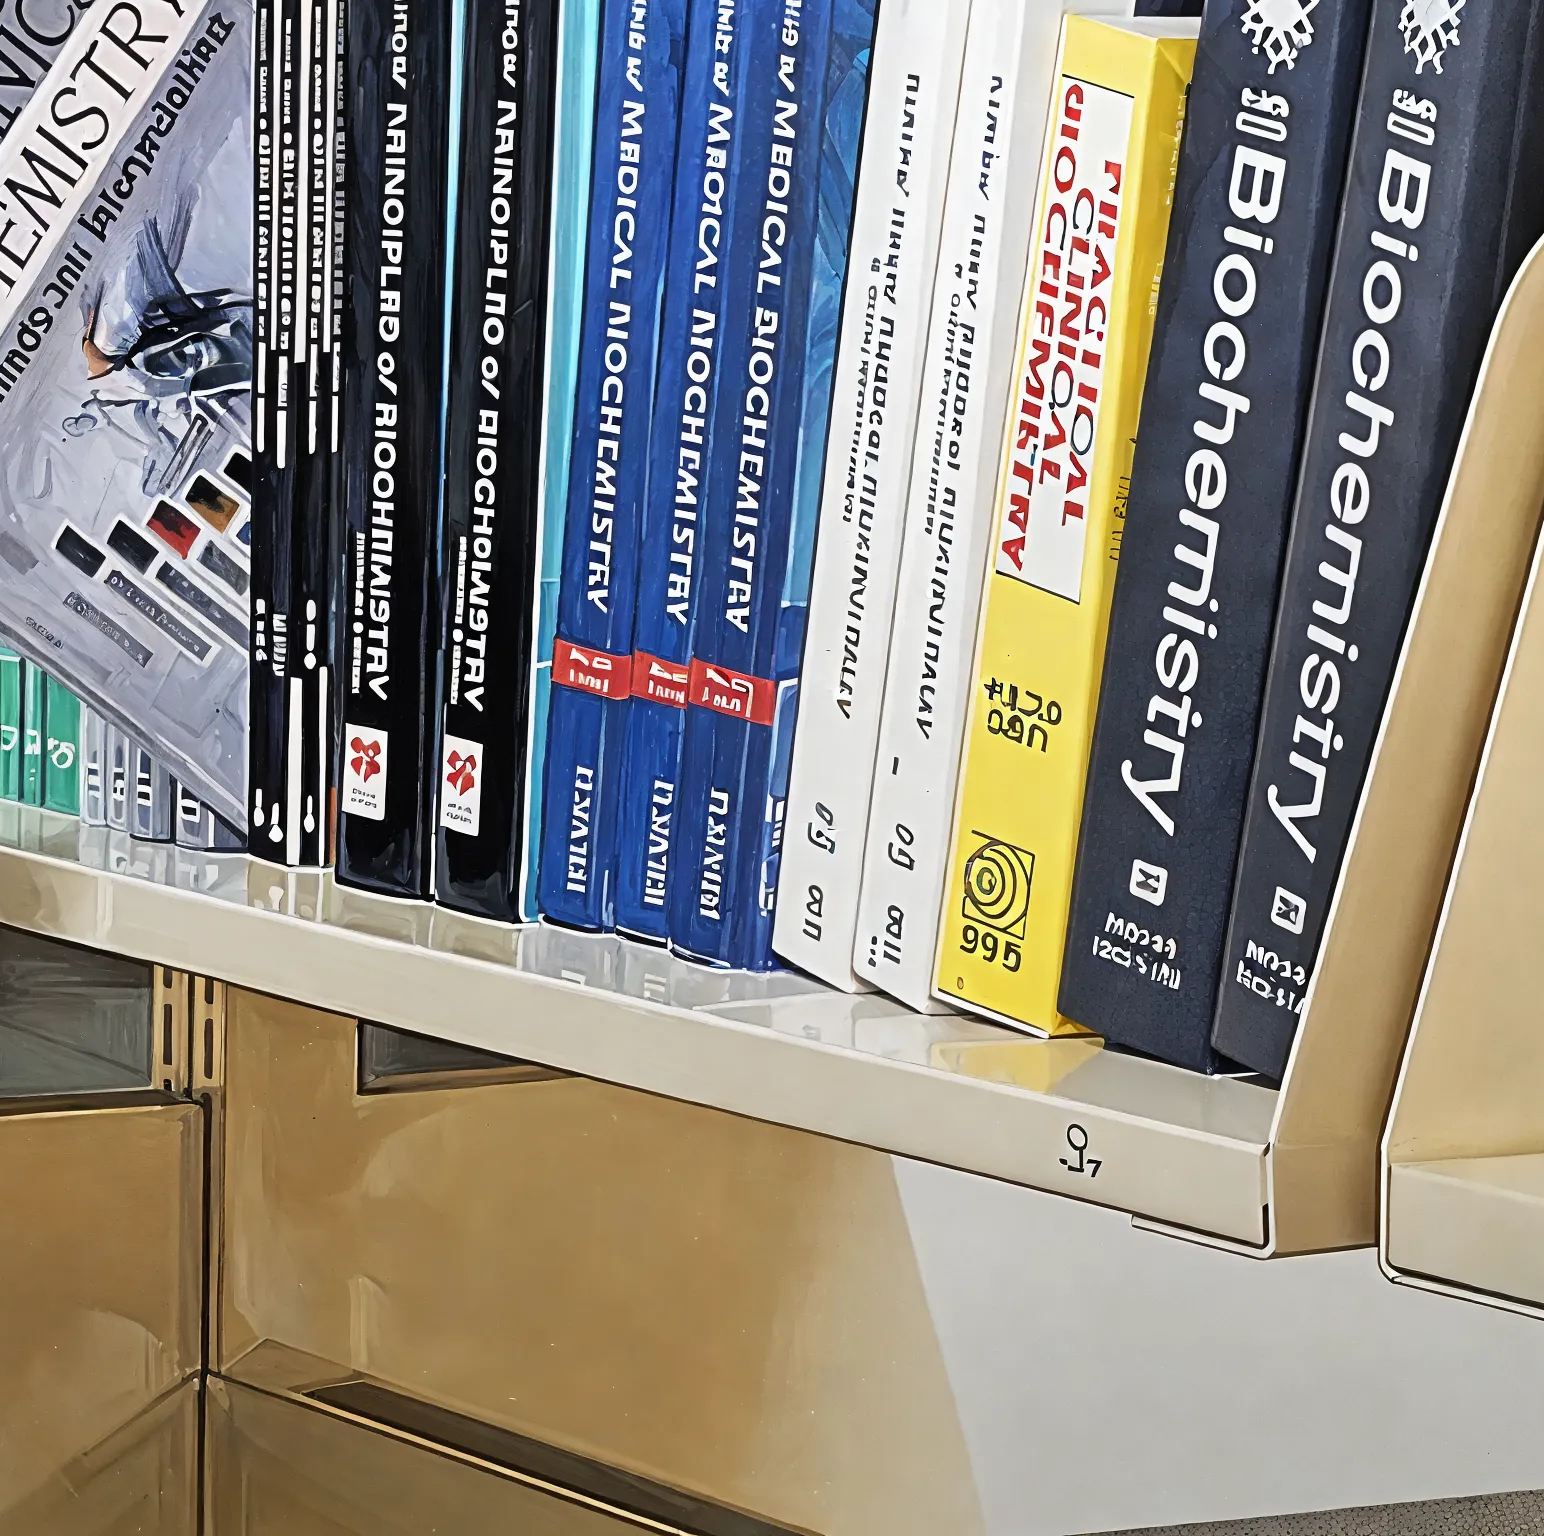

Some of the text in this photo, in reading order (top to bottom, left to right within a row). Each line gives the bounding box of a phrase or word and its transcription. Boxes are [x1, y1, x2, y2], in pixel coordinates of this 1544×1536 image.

[757, 99, 798, 297] MEDICAL
[1120, 144, 1289, 836] Biochemistry
[1268, 145, 1433, 863] Biochemistry
